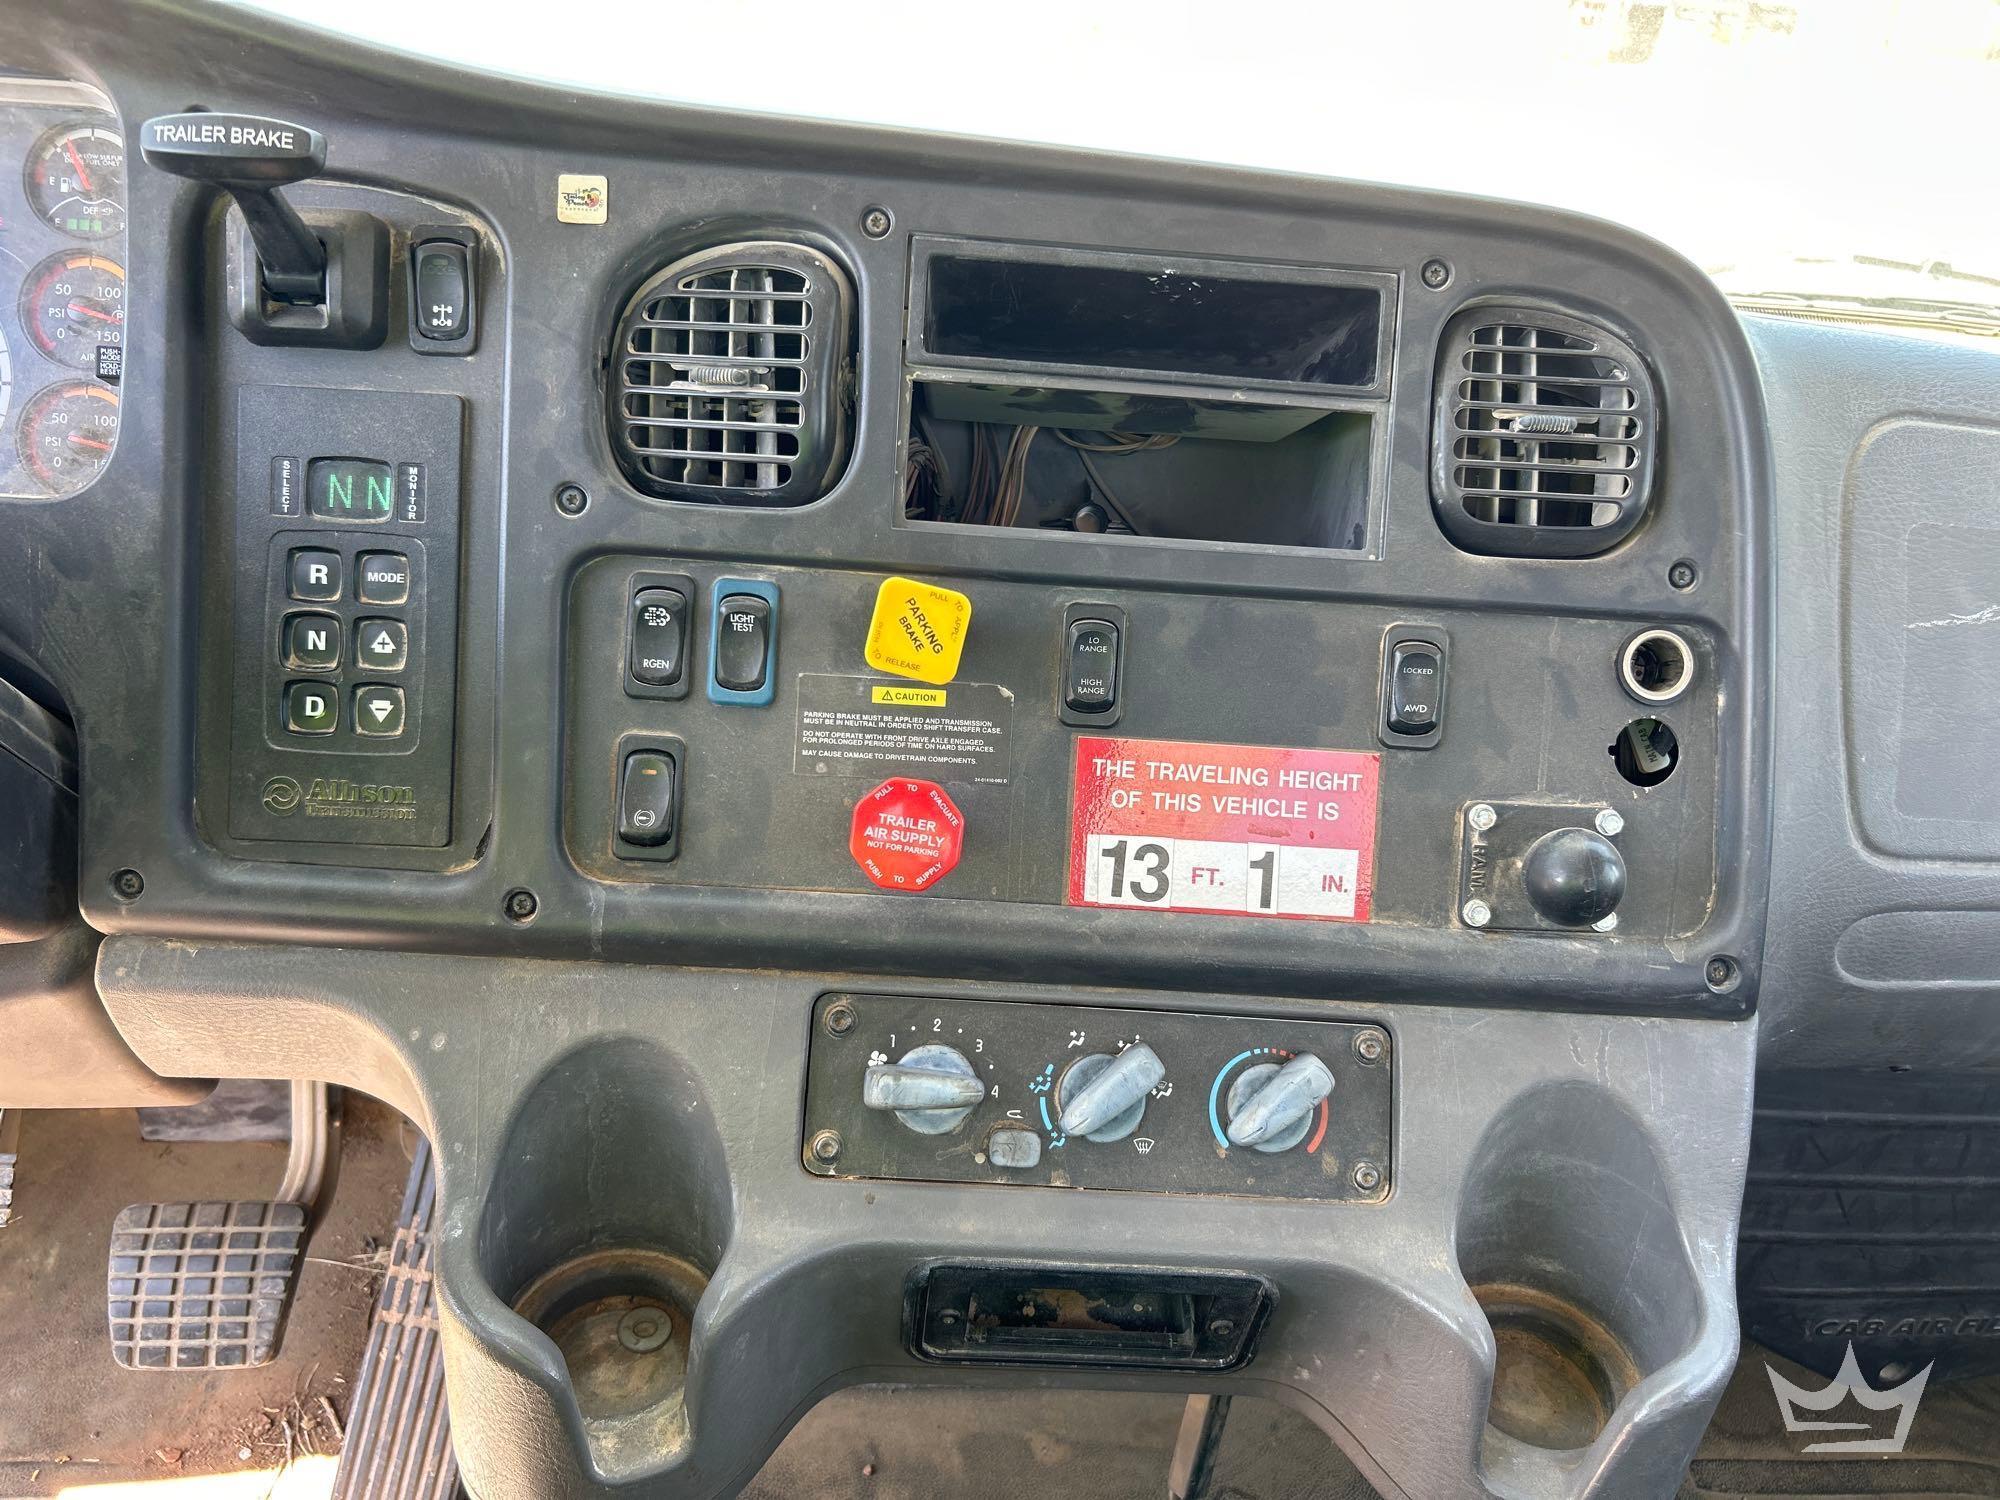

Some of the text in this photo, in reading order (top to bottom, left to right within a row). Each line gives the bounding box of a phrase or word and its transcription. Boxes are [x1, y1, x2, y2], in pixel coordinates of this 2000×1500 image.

[154, 125, 294, 150] TRAILER BRAKE
[83, 206, 98, 215] DEF
[55, 284, 72, 296] 50
[97, 286, 121, 299] 100
[48, 307, 65, 319] PSI
[57, 328, 66, 339] 0
[96, 330, 120, 343] 150
[80, 352, 96, 362] AIR
[51, 412, 68, 424] 50
[94, 415, 117, 427] 100
[45, 436, 61, 447] PSI
[53, 456, 62, 468] 0
[282, 460, 291, 513] SELECT
[329, 474, 392, 511] N N
[408, 466, 418, 520] MONITOR
[309, 564, 328, 585] R
[367, 571, 405, 584] MODE
[930, 591, 949, 602] PULL
[954, 601, 963, 612] TO
[730, 614, 756, 624] LIGHT
[905, 597, 943, 655] PARKING
[732, 622, 754, 632] TEST
[899, 616, 925, 652] BRAKE
[307, 630, 327, 651] N
[1079, 644, 1108, 653] RANGE
[643, 658, 670, 669] RGEN
[872, 648, 882, 660] TO
[885, 656, 921, 672] RELEASE
[1403, 667, 1433, 675] LOCKED
[1080, 678, 1103, 686] HIGH
[895, 692, 937, 702] CAUTION
[1077, 687, 1105, 695] RANGE
[305, 696, 325, 717] D
[1403, 704, 1428, 713] AWD
[803, 711, 835, 719] PARKING
[836, 712, 861, 720] BRAKE
[894, 716, 924, 724] APPLIED
[940, 718, 993, 727] TRANSMISSION
[844, 720, 877, 728] NEUTRAL
[944, 725, 981, 733] TRANSFER
[819, 737, 863, 746] PROLONGED
[864, 739, 895, 748] PERIODS
[957, 745, 996, 753] SURFACES.
[831, 732, 864, 740] OPERATE
[883, 734, 907, 742] FRONT
[908, 735, 929, 743] DRIVE
[950, 738, 984, 746] ENGAGED
[843, 751, 874, 759] DAMAGE
[885, 753, 927, 762] DRIVETRAIN
[927, 755, 978, 765] COMPONENTS.
[1093, 758, 1363, 793] THE TRAVELING HEIGHT
[305, 778, 416, 804] Allison
[306, 803, 417, 820] Transmission
[874, 783, 960, 827] PULL TO EVACUATE
[1111, 789, 1340, 822] OF THIS VEHICLE IS
[878, 813, 937, 833] TRAILER
[864, 826, 945, 848] AIR SUPPLY
[867, 840, 940, 858] NOT FOR PARKING
[865, 858, 942, 885] PUSH TO SUPPLY
[1101, 839, 1349, 909] 13 FT. 1 IN.
[932, 1018, 942, 1032] 2
[889, 1034, 896, 1048] 1
[974, 1038, 983, 1053] 3
[990, 1084, 999, 1099] 4
[1814, 1318, 1886, 1337] CAB
[1888, 1317, 1953, 1336] AIR
